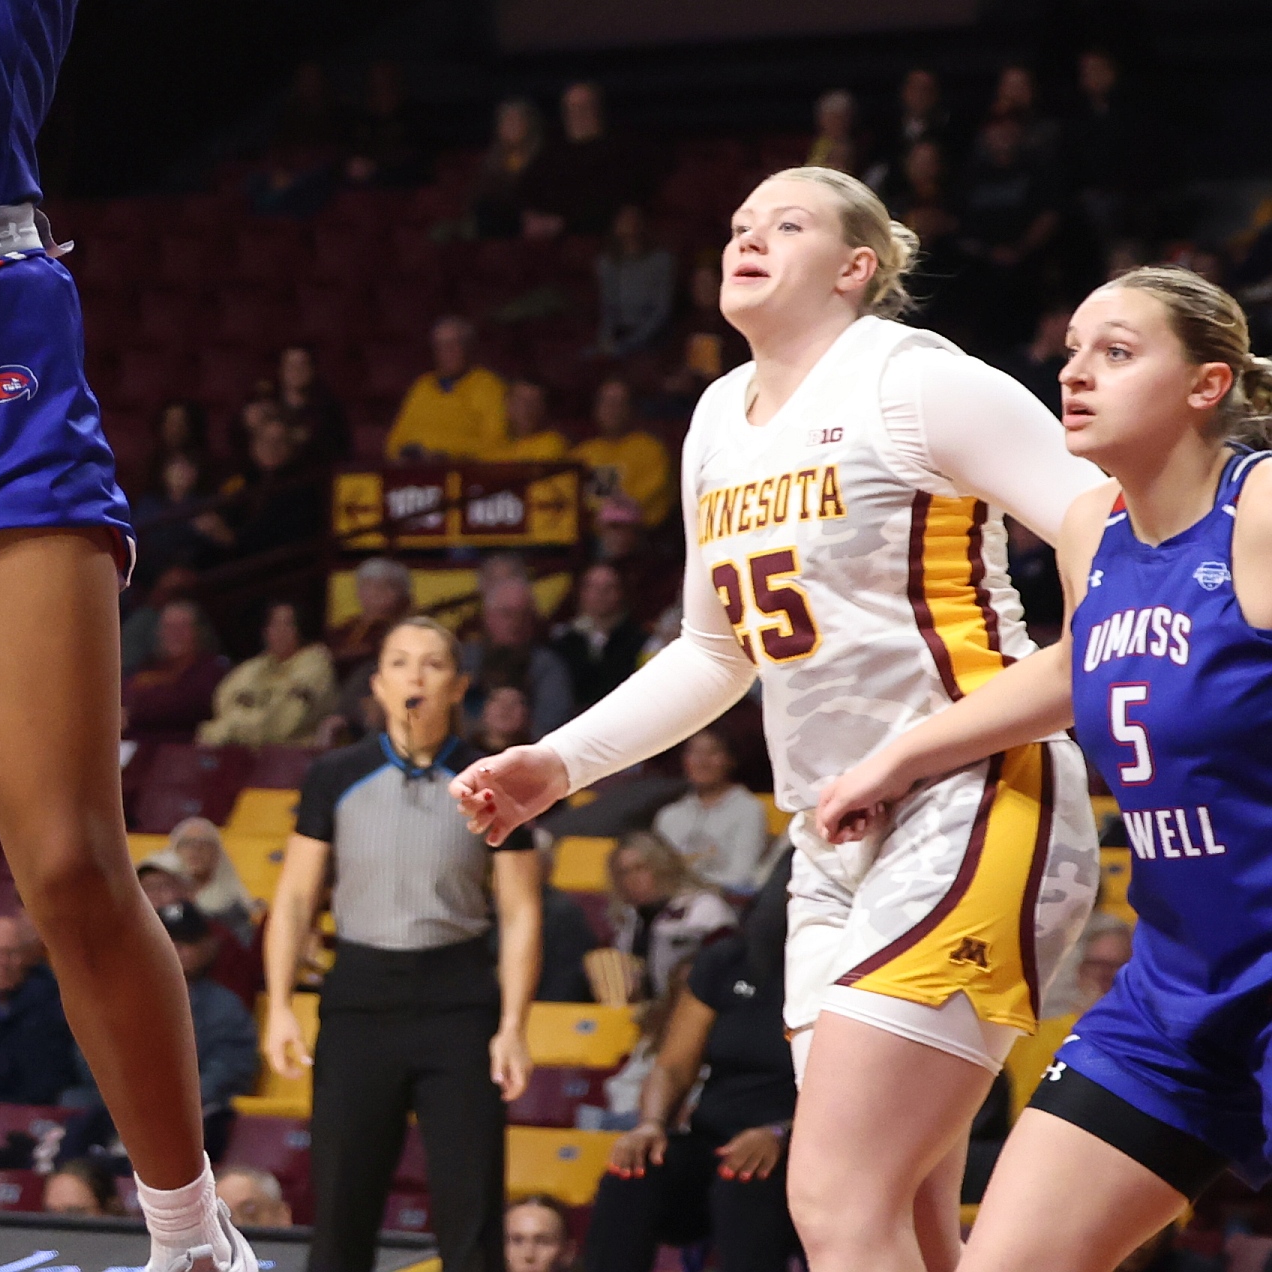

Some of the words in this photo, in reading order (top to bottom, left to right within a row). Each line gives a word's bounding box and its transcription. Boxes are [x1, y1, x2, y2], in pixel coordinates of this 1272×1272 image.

[1083, 606, 1191, 672] UMASS
[1109, 681, 1154, 786] 5
[1122, 805, 1227, 861] WELL
